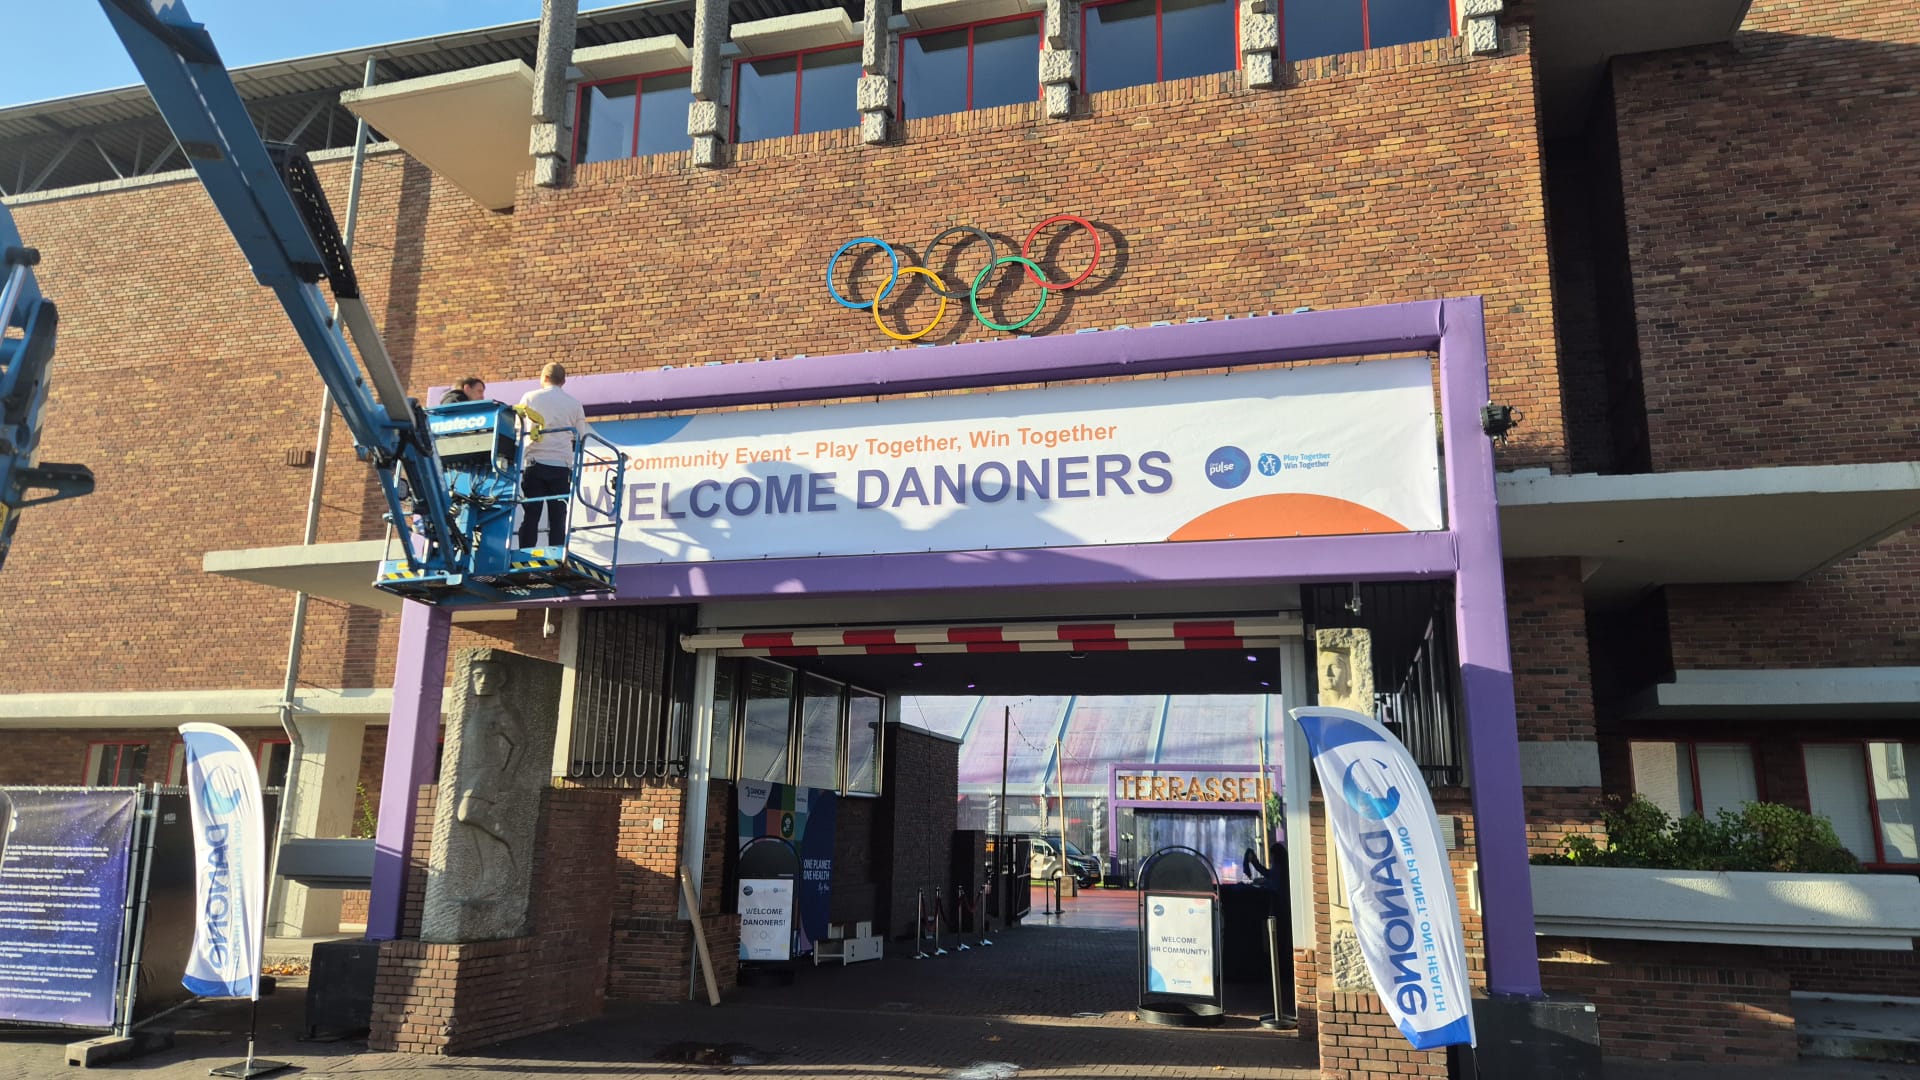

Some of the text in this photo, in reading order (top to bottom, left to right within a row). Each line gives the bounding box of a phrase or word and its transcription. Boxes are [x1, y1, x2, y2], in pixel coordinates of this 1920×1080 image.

[430, 415, 487, 433] mateco
[735, 445, 792, 465] Event
[815, 440, 859, 461] Play
[865, 434, 962, 458] Together,
[968, 429, 1010, 449] Win
[1017, 423, 1118, 448] Together
[1283, 452, 1331, 463] Play Together
[1209, 461, 1235, 476] pulse
[1283, 460, 1330, 470] Win Together
[583, 450, 1174, 523] WELCOME DANONERS
[745, 907, 784, 916] WELCOME
[742, 919, 786, 927] DANONERS!
[1161, 935, 1197, 945] WELCOME
